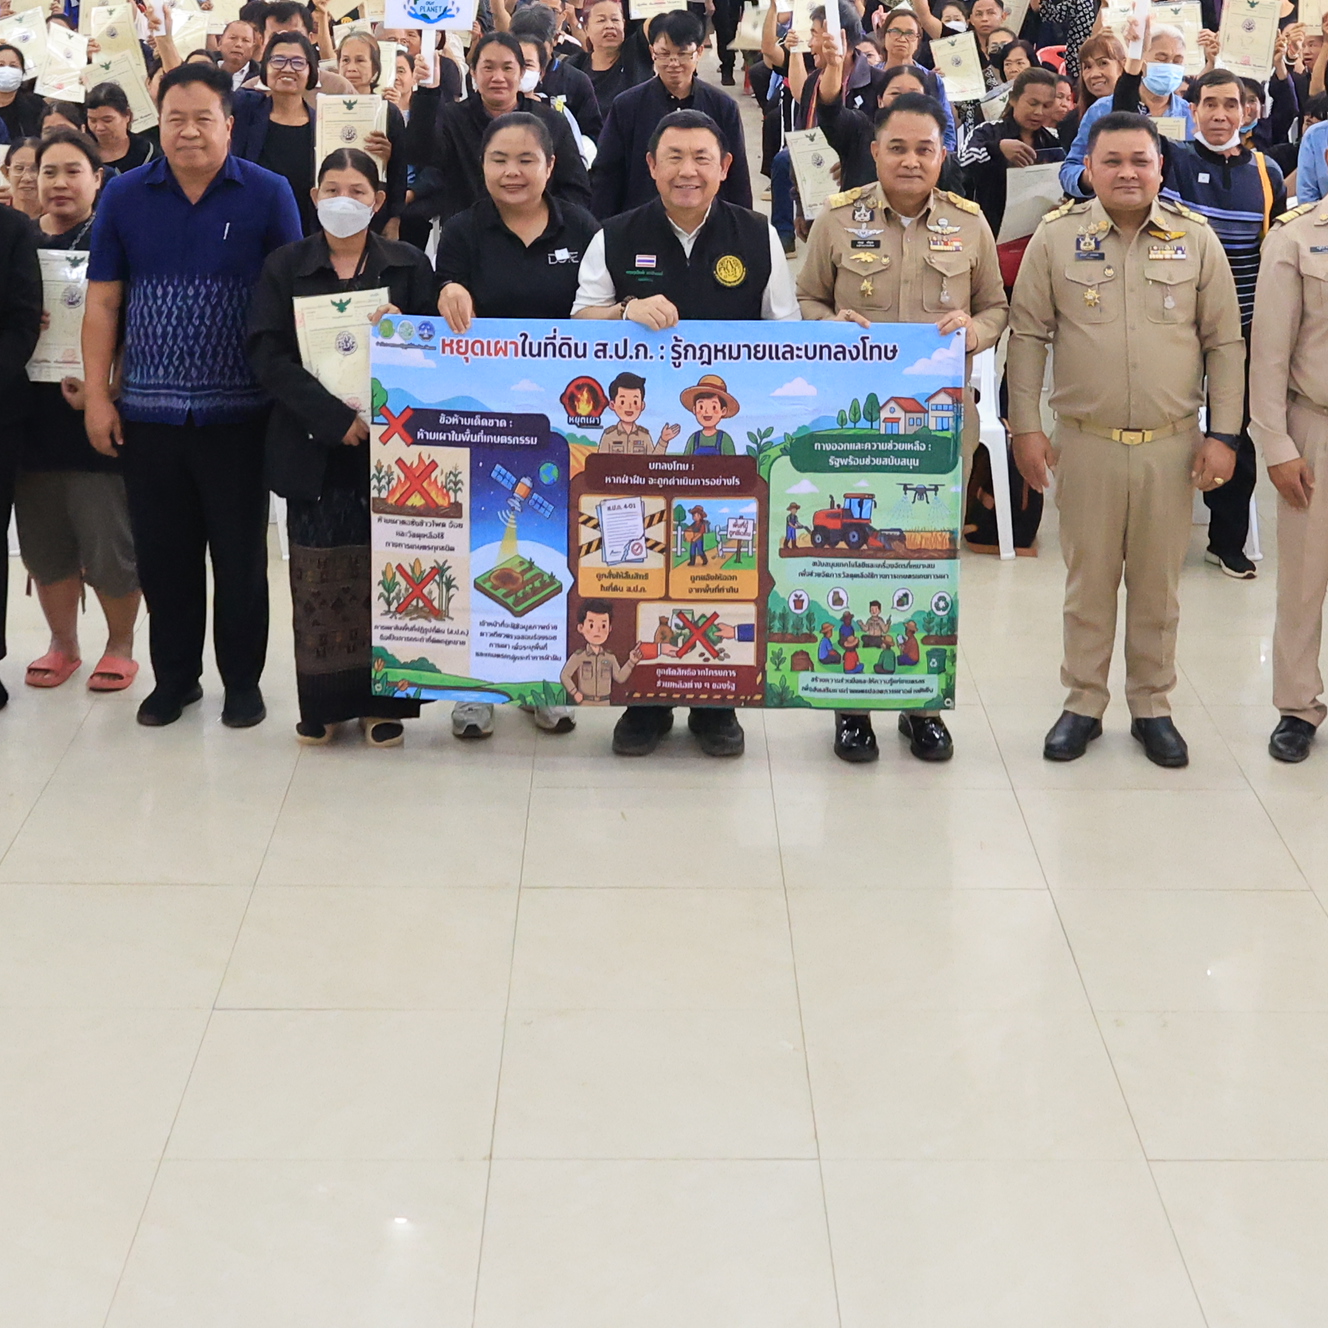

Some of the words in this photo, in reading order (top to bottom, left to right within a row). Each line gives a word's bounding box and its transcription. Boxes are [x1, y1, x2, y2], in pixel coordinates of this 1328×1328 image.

[548, 251, 579, 264] DE
[440, 328, 587, 364] หยุดเผาในที่ดิน
[594, 339, 654, 360] ส.ป.ก.
[670, 335, 898, 367] รู้กฎหมายและบทลงโทษ
[439, 412, 506, 427] ข้อห้ามเด็ดขาด
[568, 416, 601, 427] หยุดเผา
[416, 429, 538, 445] ห้ามเผาในพื้นที่เกษตรกรรม
[814, 439, 926, 453] ทางออกและความช่วยเหลือ
[648, 460, 689, 471] บทลงโทษ
[828, 455, 919, 470] รัฐพร้อมช่วยสนับสนุน
[605, 474, 646, 485] หากฝ่าฝืน
[648, 475, 741, 488] จะถูกดำเนินการอย่างไร
